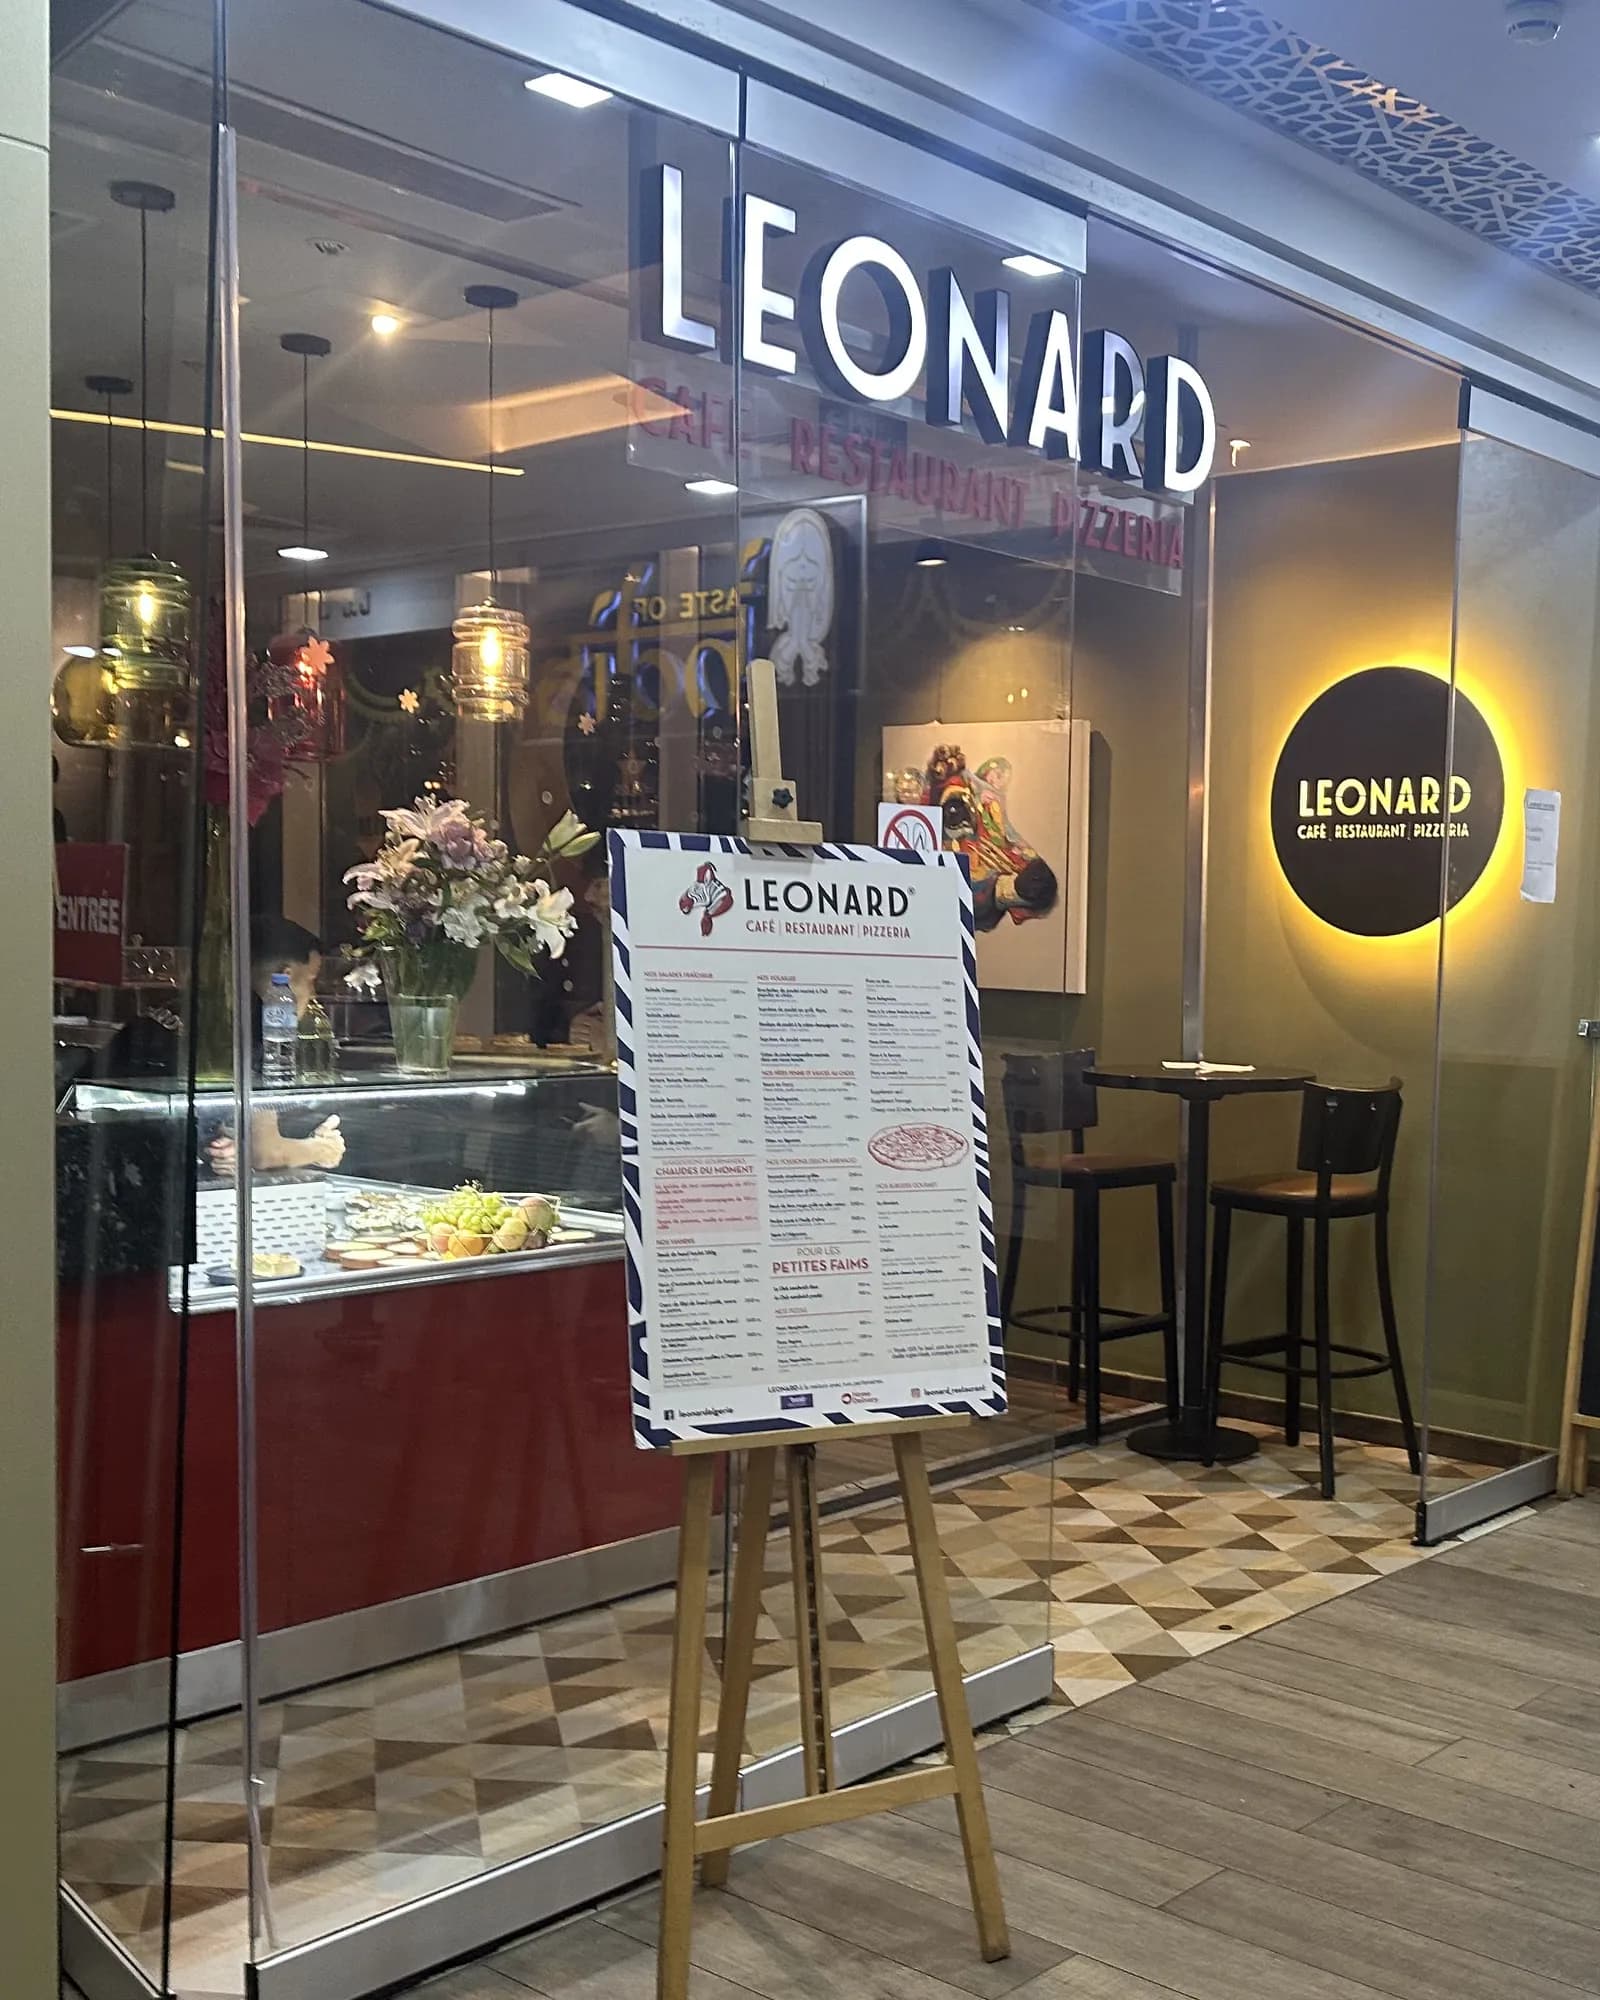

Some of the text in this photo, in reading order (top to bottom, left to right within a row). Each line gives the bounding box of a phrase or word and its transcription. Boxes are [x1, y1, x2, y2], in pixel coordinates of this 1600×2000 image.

[648, 163, 1217, 494] LEONARD
[791, 416, 1029, 529] RESTAURANT
[1055, 490, 1184, 569] PIZZERIA
[1299, 775, 1472, 818] LEONARD
[1297, 823, 1327, 840] CAFÉ
[1335, 823, 1406, 839] RESTAURANT
[746, 919, 912, 939] CAFÉ RESTAURANT PIZZERIA
[714, 1165, 753, 1175] MOMENT
[772, 1257, 869, 1274] PETITES FAIMS
